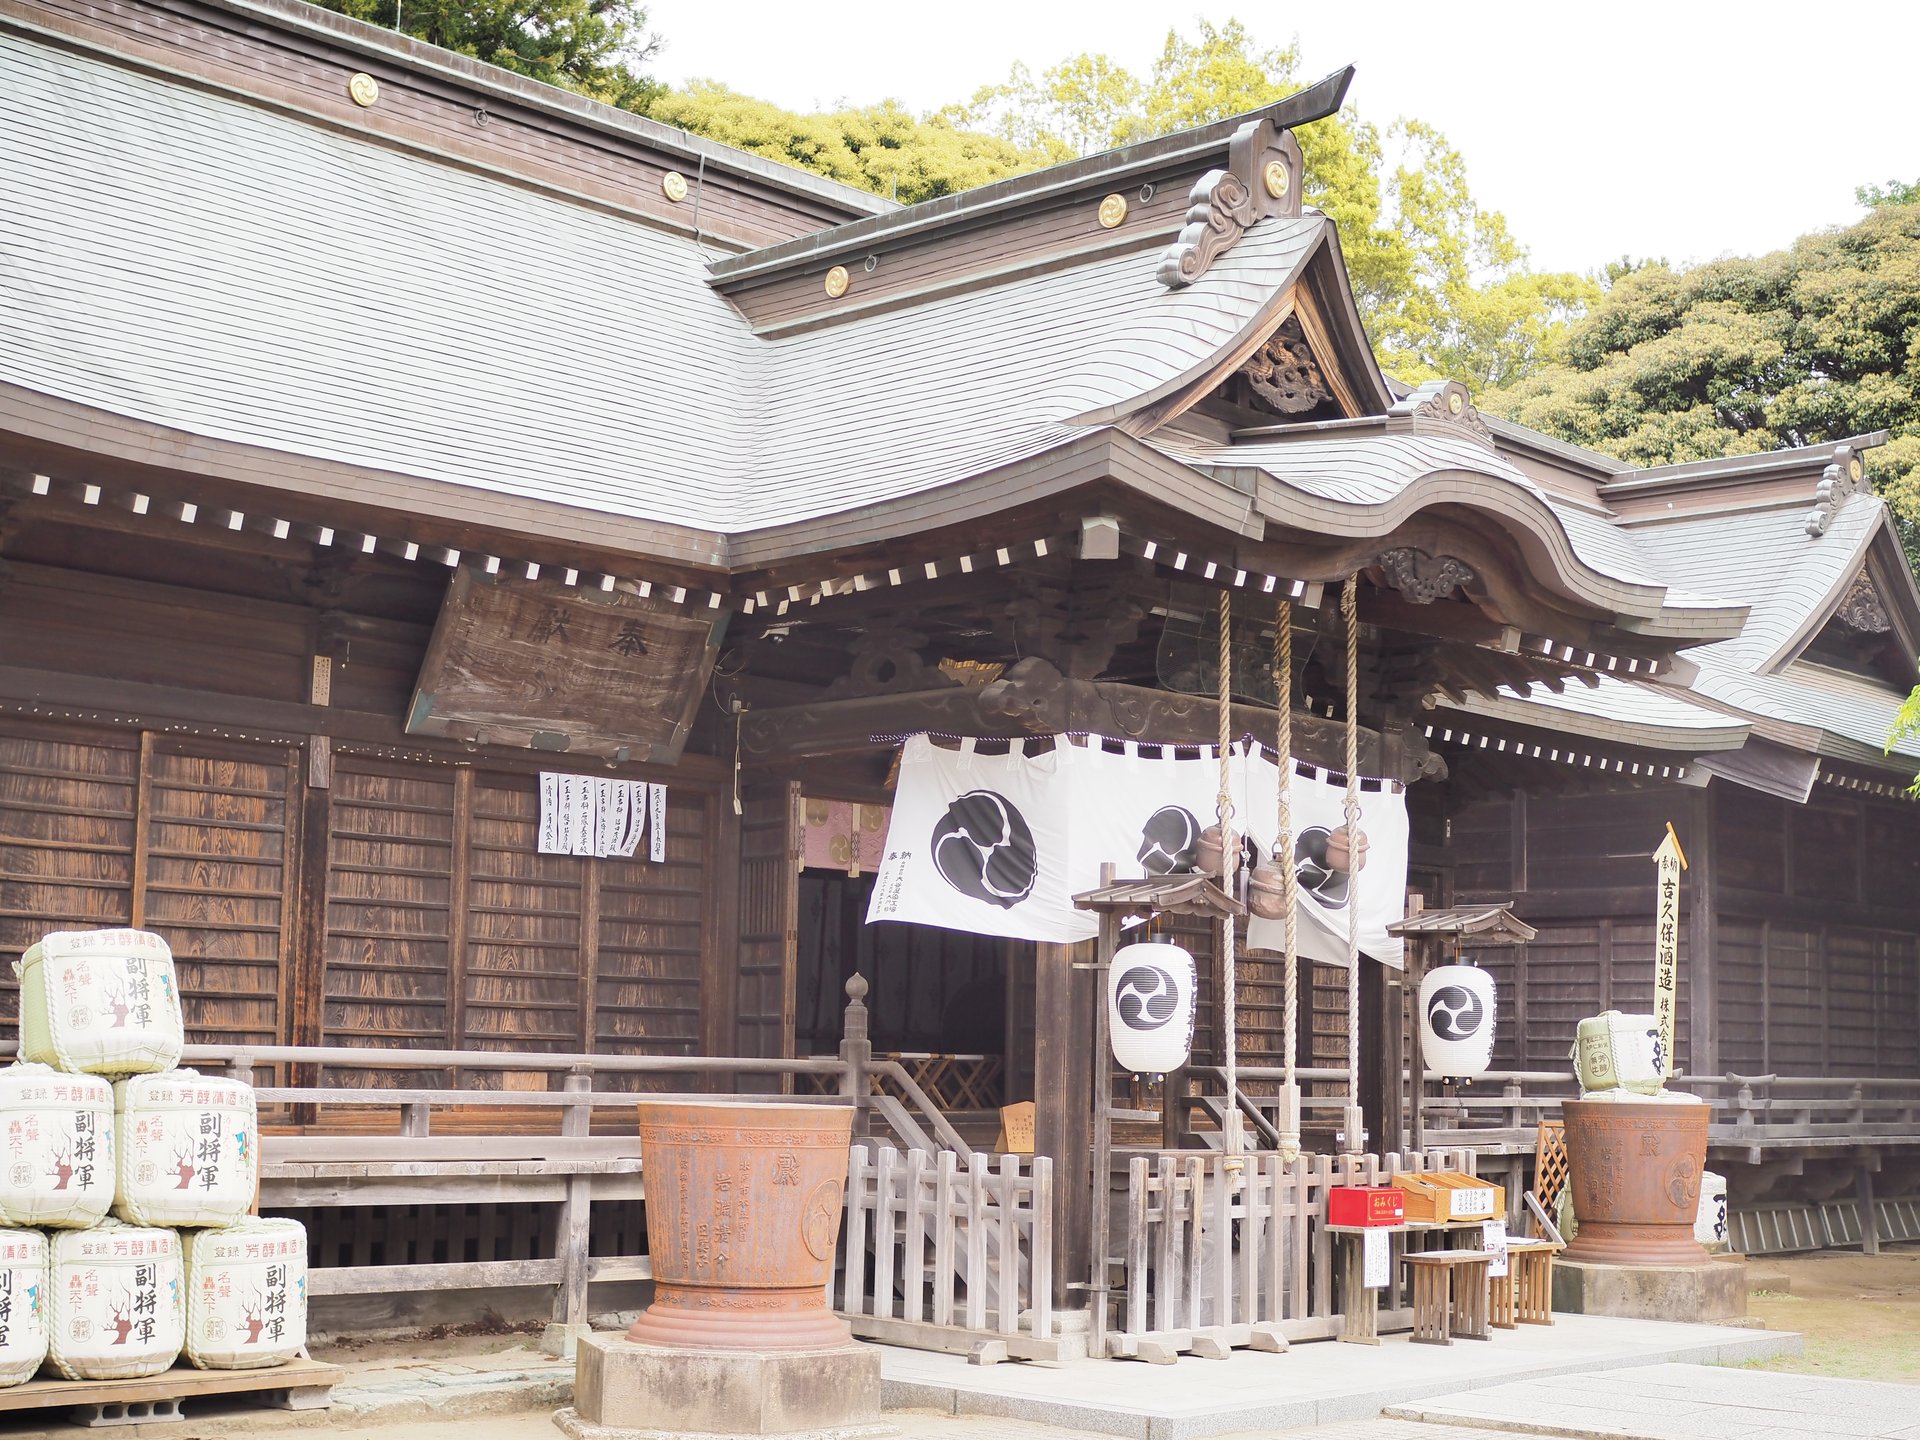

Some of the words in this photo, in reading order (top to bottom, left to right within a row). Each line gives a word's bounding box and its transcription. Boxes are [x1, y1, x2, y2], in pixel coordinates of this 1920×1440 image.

[1661, 856, 1678, 872] 奉納
[1658, 877, 1677, 991] 吉久保酒造
[126, 957, 152, 1029] 副将軍
[1658, 997, 1670, 1057] 株式会社
[74, 1110, 96, 1192] 副将軍
[197, 1112, 223, 1192] 副将軍
[1373, 1196, 1399, 1208] おみくじ
[133, 1263, 157, 1345] 副将軍
[264, 1263, 287, 1344] 副将軍
